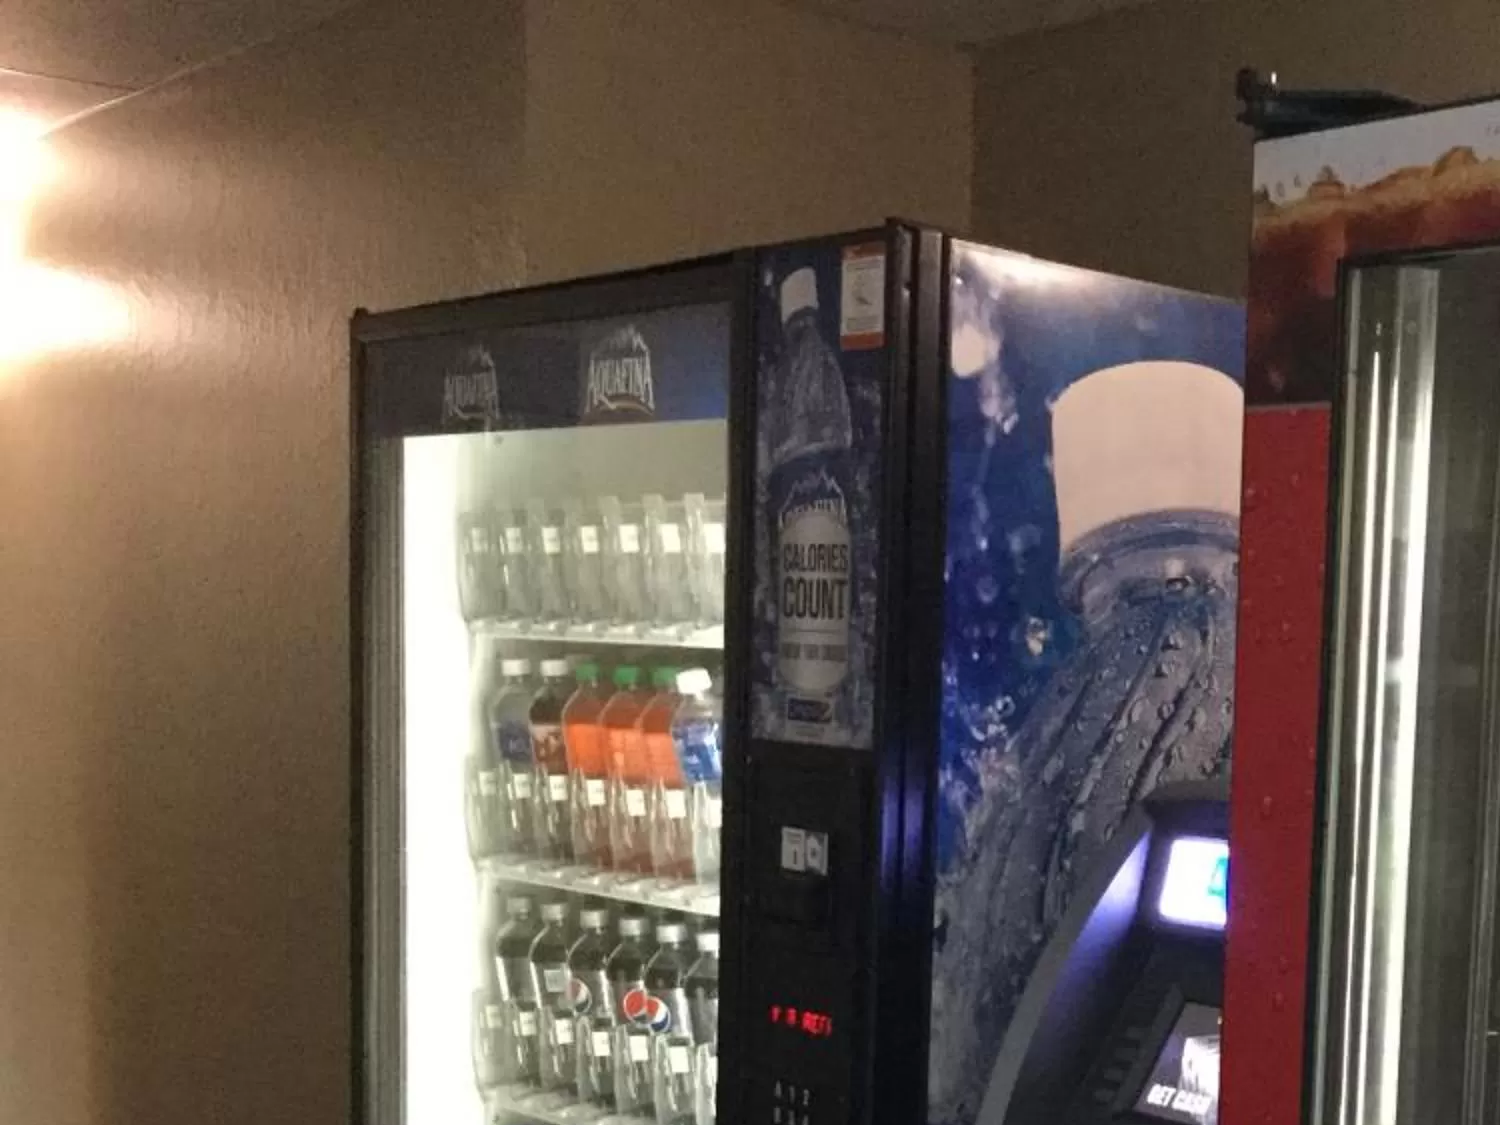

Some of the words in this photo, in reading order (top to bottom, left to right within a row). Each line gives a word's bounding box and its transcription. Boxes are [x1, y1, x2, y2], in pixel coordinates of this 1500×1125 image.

[783, 543, 849, 573] CALORIES
[783, 575, 849, 620] COUNT
[1147, 1083, 1177, 1108] GET
